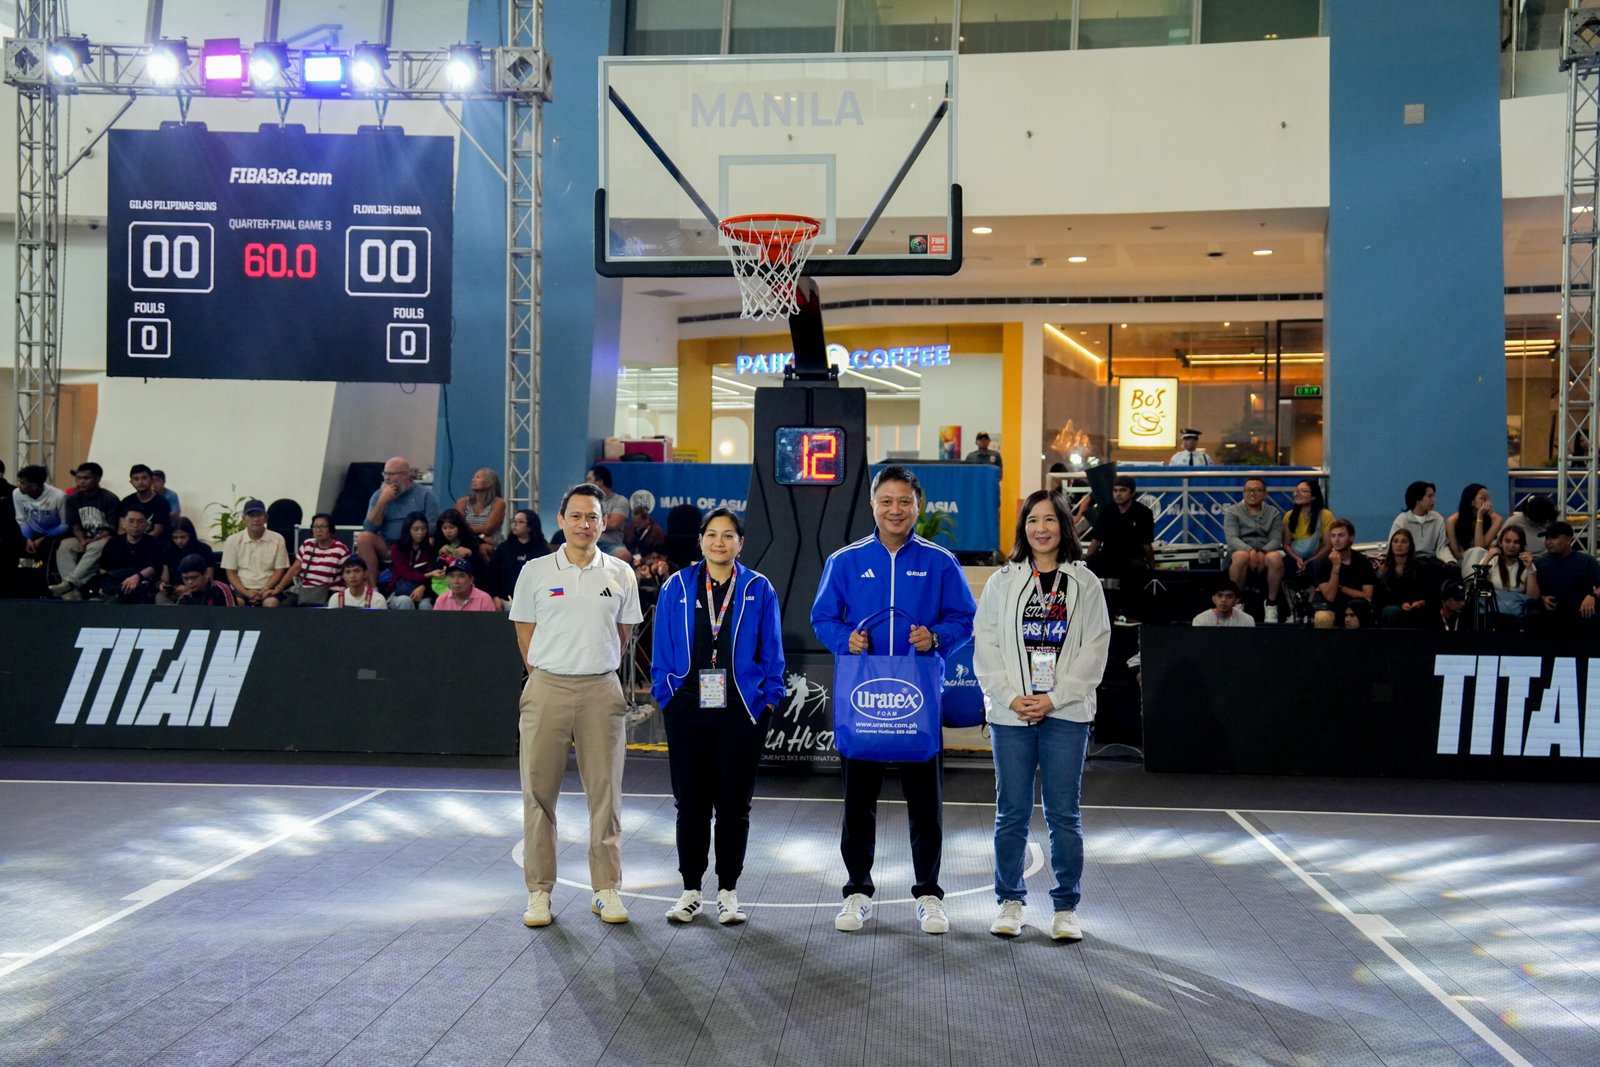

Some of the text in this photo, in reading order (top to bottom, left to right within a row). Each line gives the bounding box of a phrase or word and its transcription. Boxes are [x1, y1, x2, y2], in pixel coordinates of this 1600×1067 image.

[691, 91, 864, 127] MANILA
[229, 167, 332, 185] FIBA3x3.com
[129, 200, 217, 211] GILAS PILIPINAS-SUNS
[353, 204, 422, 216] FLOWLISH GUNMA
[229, 218, 332, 231] QUARTER-FINAL GAME 3
[143, 234, 200, 279] 00
[245, 243, 317, 278] 60.0
[360, 238, 417, 283] 00
[134, 302, 165, 314] FOULS
[393, 307, 424, 319] FOULS
[141, 325, 157, 350] 0
[400, 330, 416, 356] 0
[736, 345, 951, 374] PAIK COFFEE
[803, 434, 836, 479] 12
[697, 498, 716, 509] OF
[925, 501, 958, 513] ASIA
[1051, 621, 1066, 641] 4
[55, 627, 261, 727] TITAN
[855, 722, 918, 730] www.uratex.com.ph
